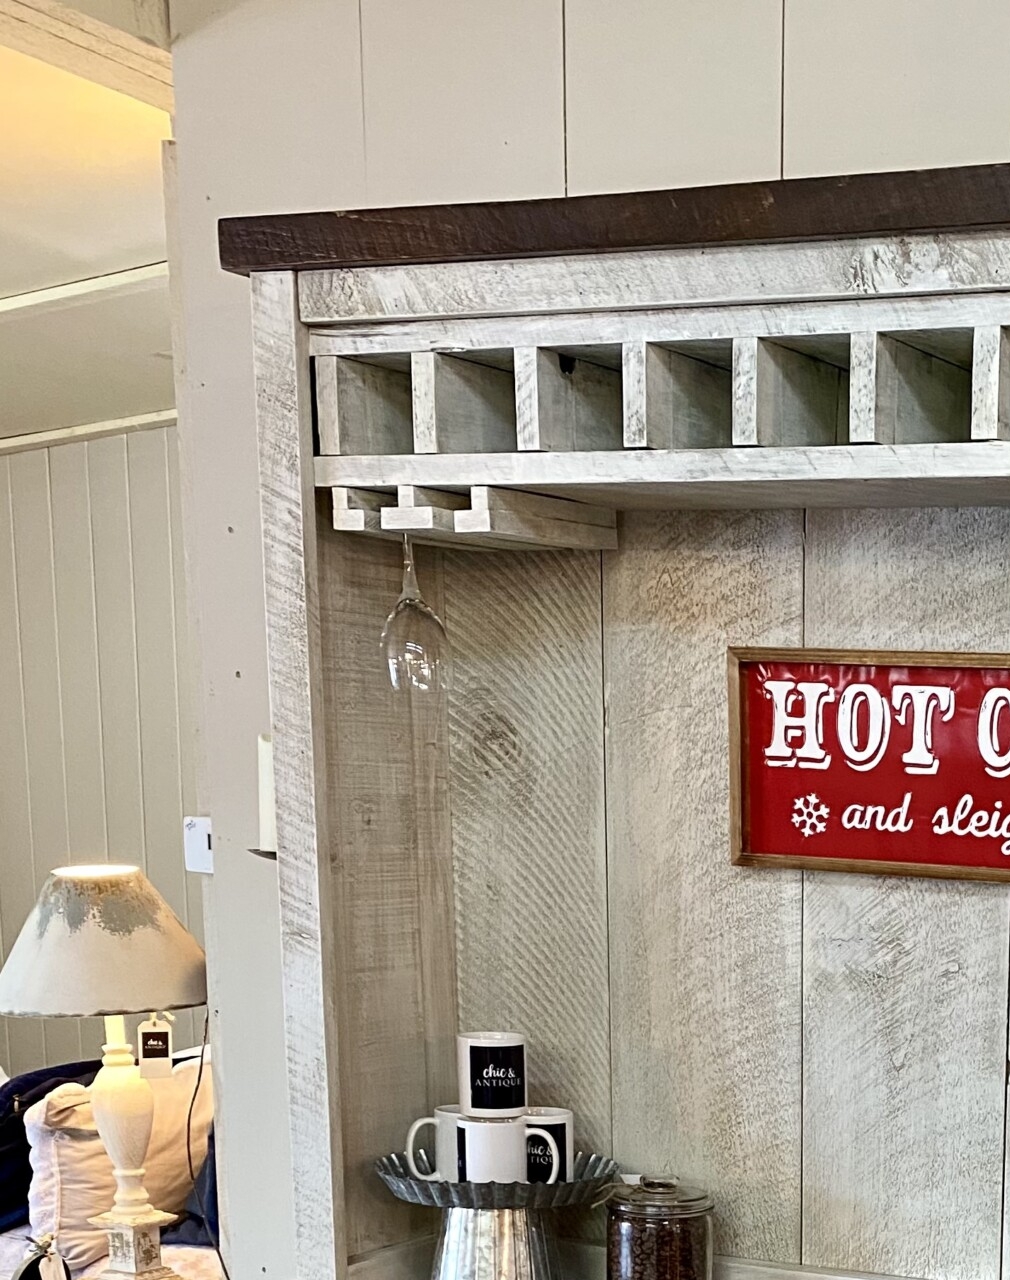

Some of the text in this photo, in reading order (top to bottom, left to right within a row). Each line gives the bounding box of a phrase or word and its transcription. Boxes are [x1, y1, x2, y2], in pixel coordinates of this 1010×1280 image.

[763, 680, 954, 775] HOT
[842, 792, 914, 833] and
[482, 1063, 516, 1078] chic &
[475, 1078, 521, 1087] ANTIQUE
[527, 1141, 546, 1156] hic
